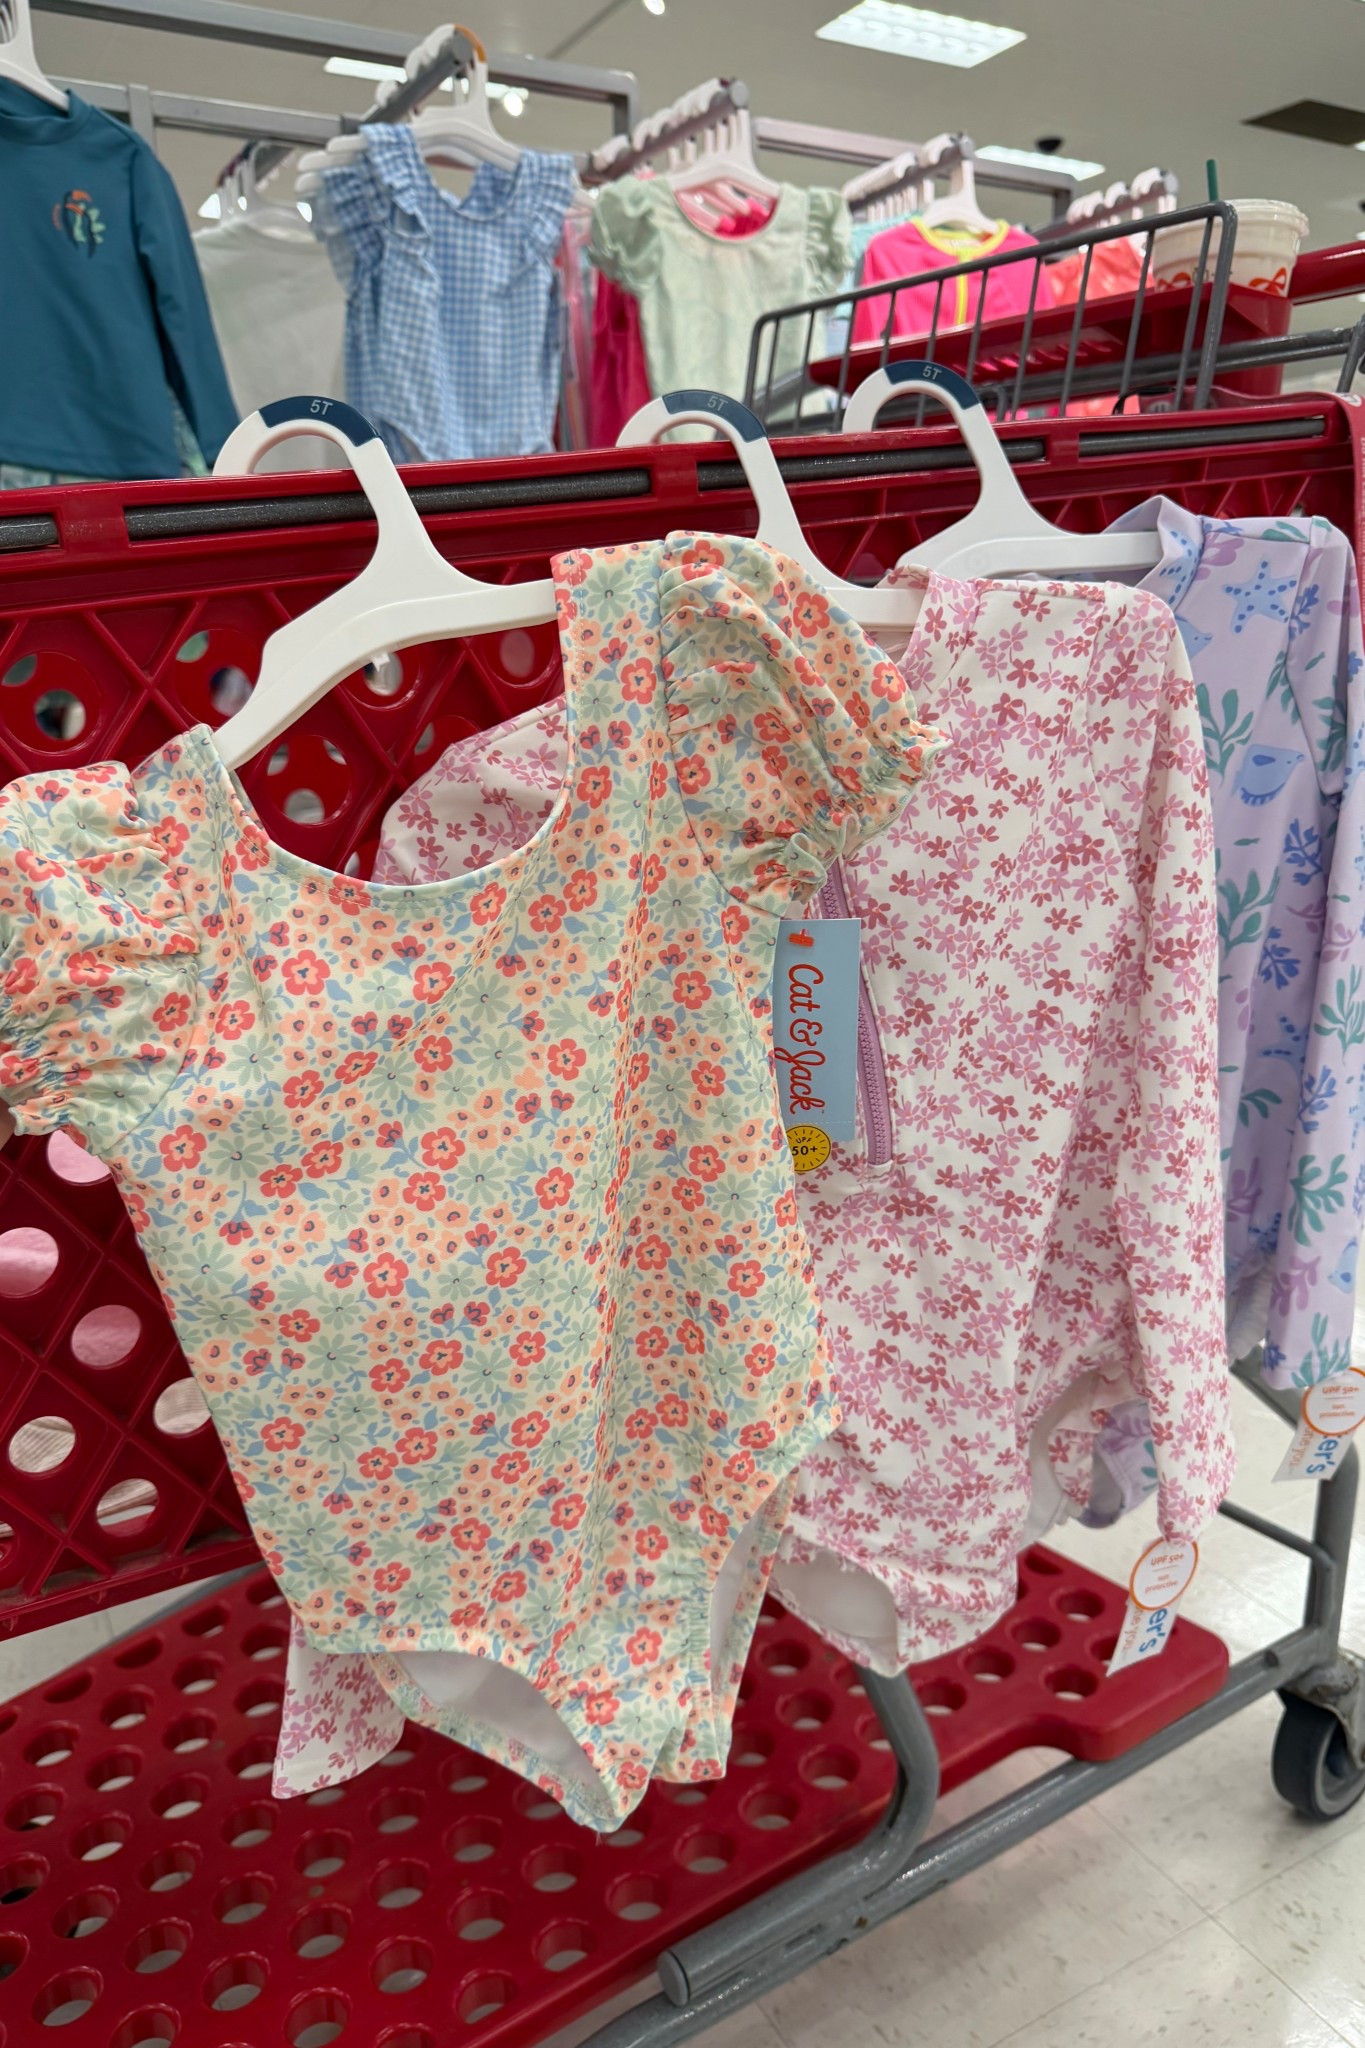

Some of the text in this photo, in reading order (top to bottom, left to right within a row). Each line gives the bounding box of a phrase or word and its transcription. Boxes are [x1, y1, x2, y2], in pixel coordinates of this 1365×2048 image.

[922, 365, 942, 380] 5T
[310, 399, 334, 416] 5T
[707, 395, 729, 412] 5T
[773, 963, 826, 1115] Cat & Jack
[795, 1136, 812, 1144] UPF
[791, 1145, 818, 1156] 50+
[1306, 1438, 1339, 1474] er's
[1150, 1554, 1169, 1567] UPF
[1138, 1607, 1168, 1653] er's
